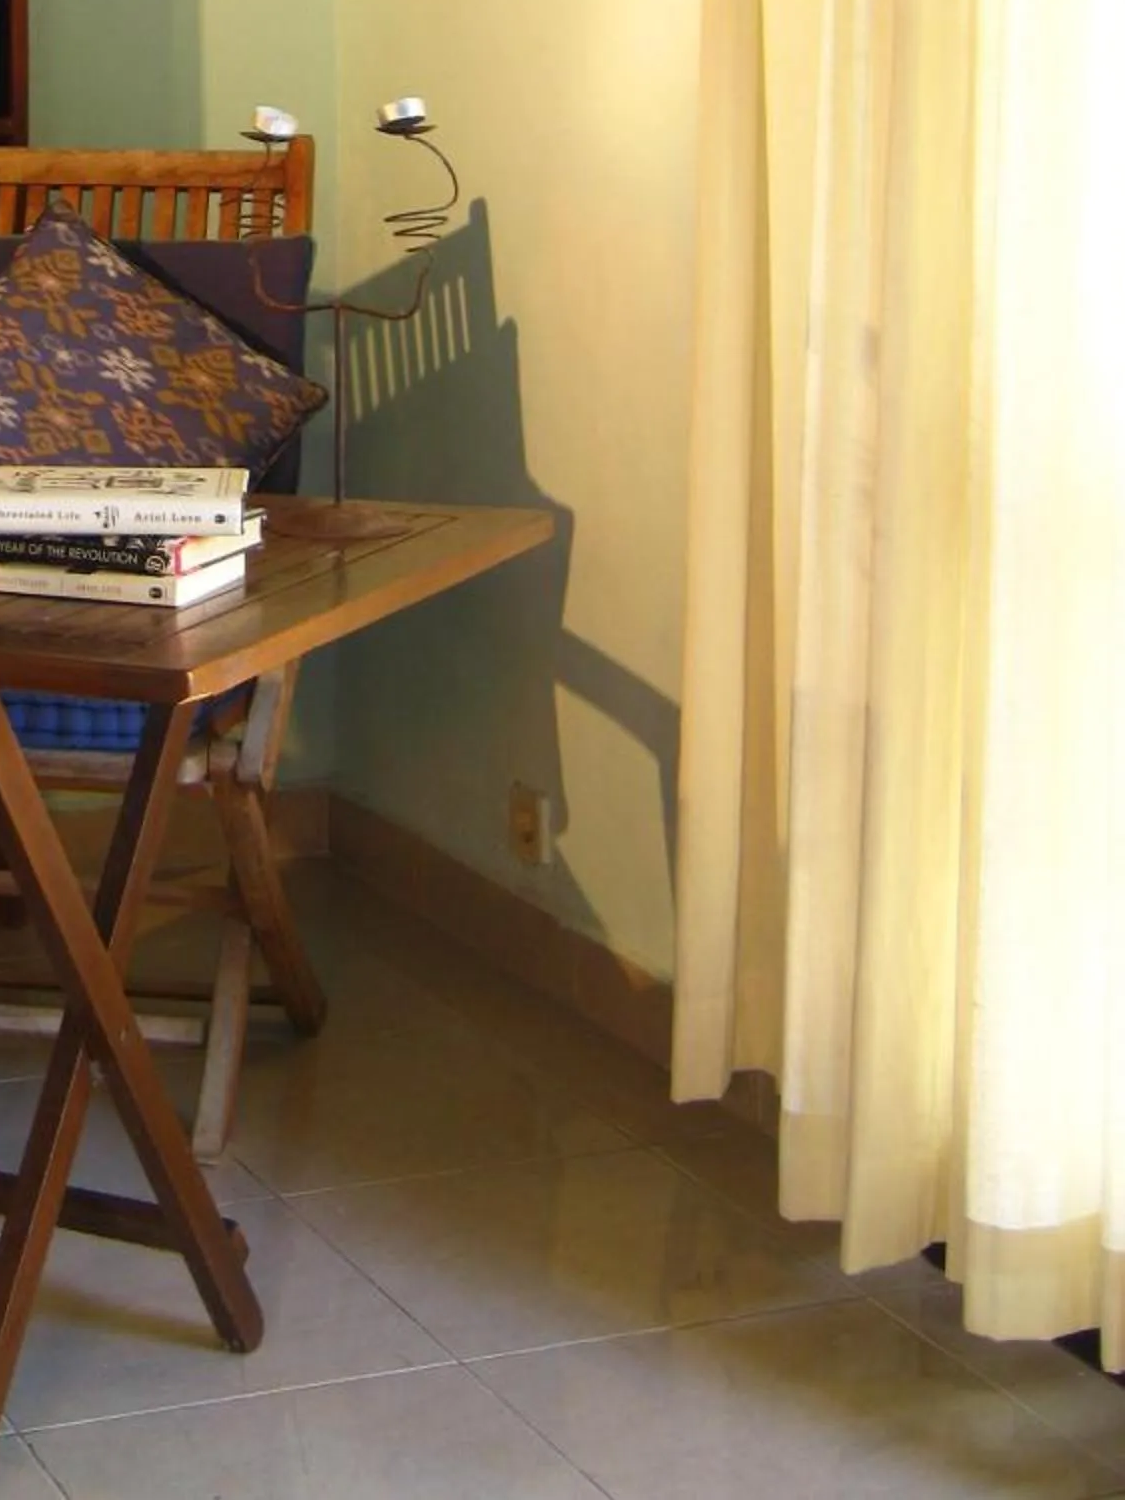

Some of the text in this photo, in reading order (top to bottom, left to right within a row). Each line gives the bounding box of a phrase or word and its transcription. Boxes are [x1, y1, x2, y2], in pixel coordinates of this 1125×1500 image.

[0, 540, 26, 554] YEAR
[28, 543, 43, 555] OF
[46, 545, 66, 559] THE
[68, 547, 139, 566] REVOLUTION
